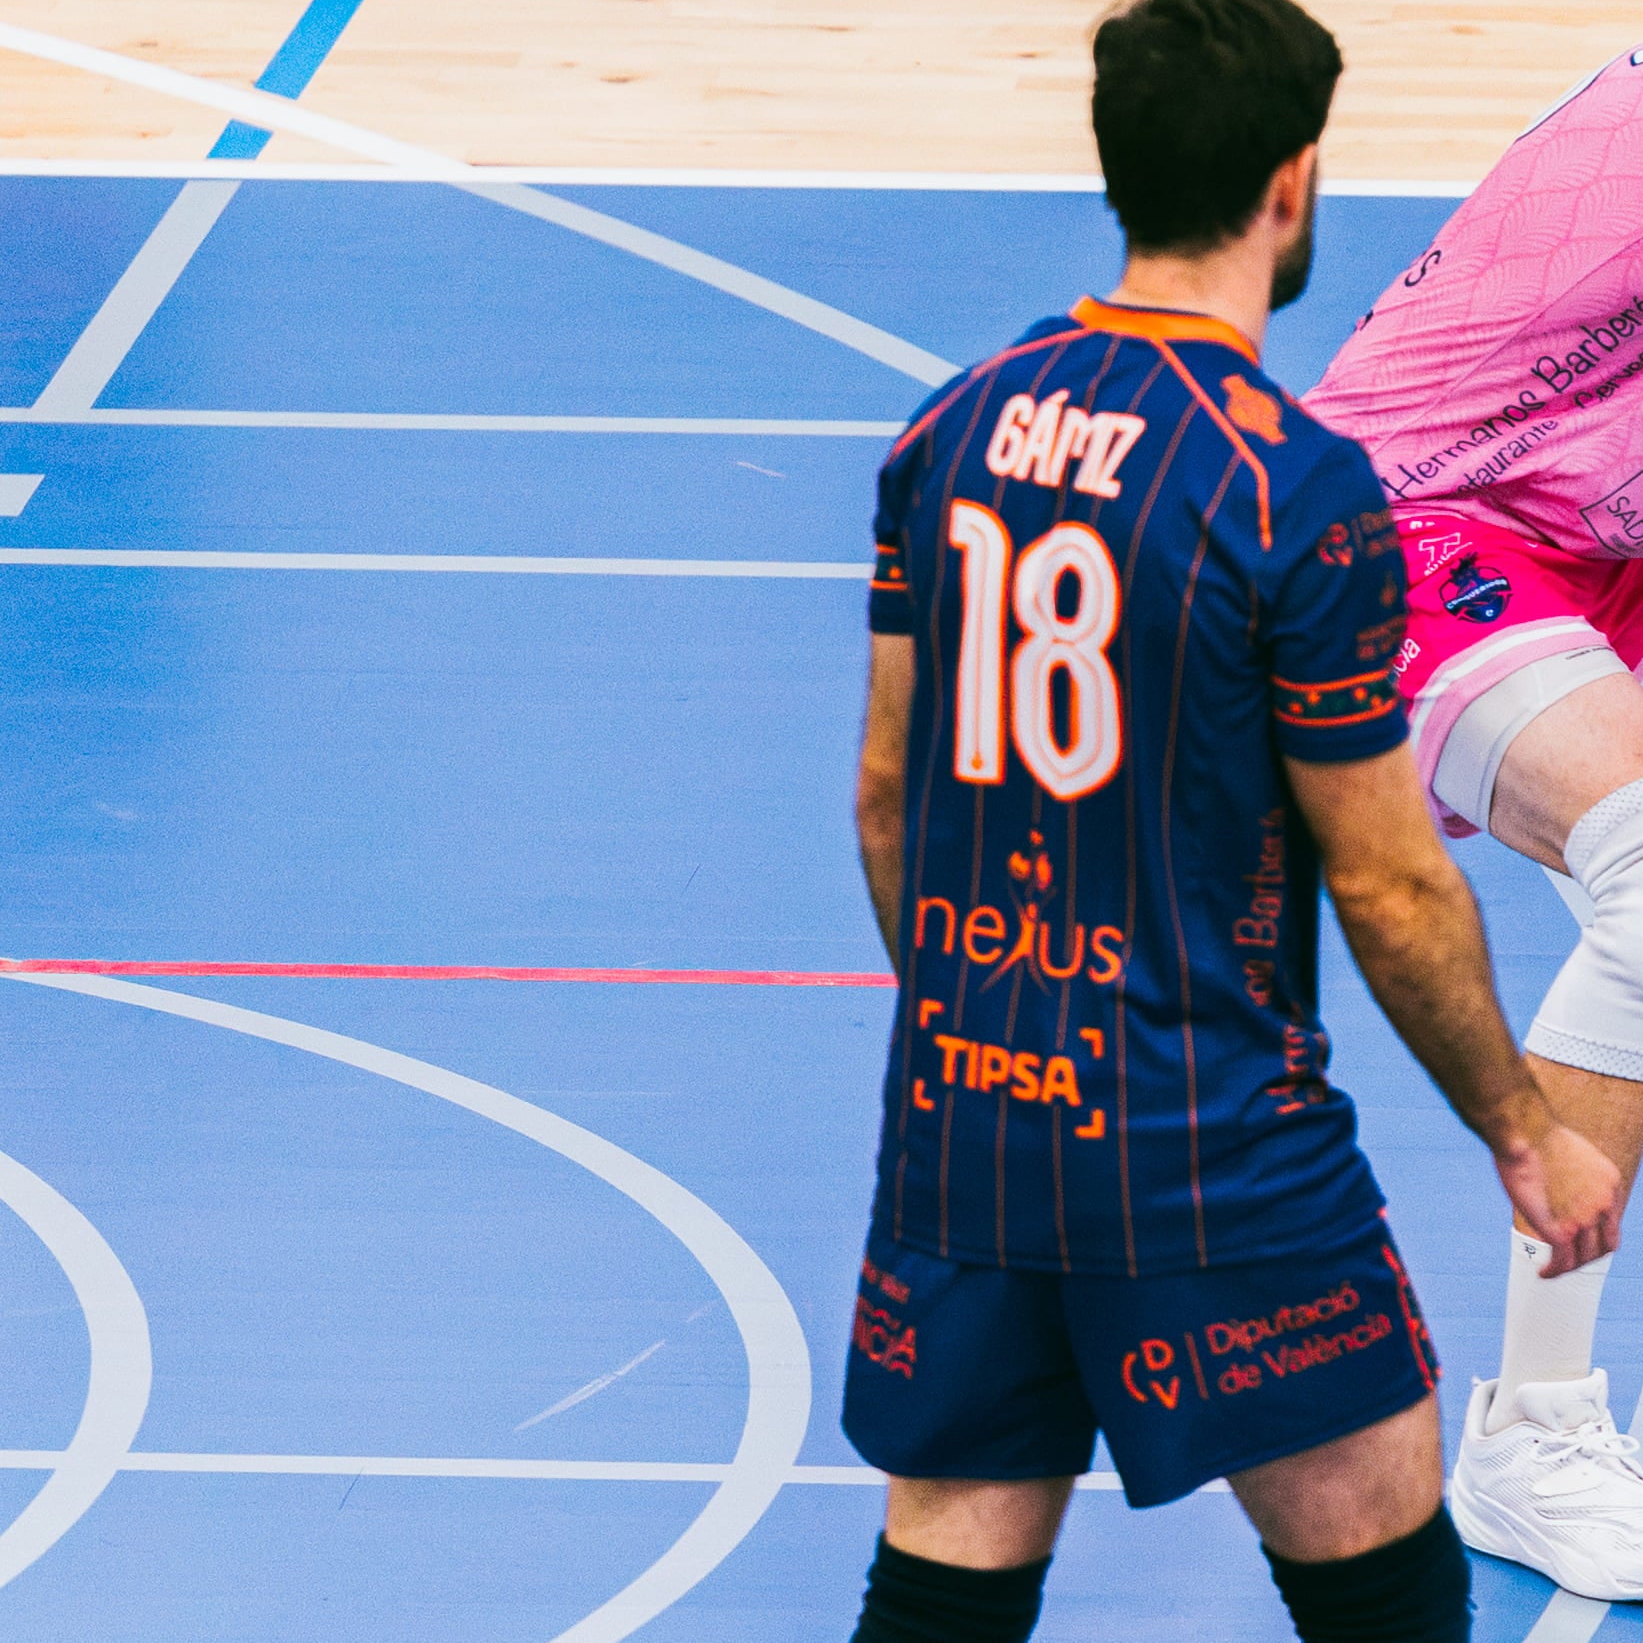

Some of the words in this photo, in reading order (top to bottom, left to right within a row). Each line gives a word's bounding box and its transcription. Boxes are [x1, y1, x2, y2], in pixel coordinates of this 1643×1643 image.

[1380, 389, 1547, 500] Hermanos
[949, 498, 1124, 803] 18
[933, 1033, 1083, 1108] TIPSA
[1204, 1280, 1360, 1356] Diputació
[1218, 1362, 1262, 1395] de
